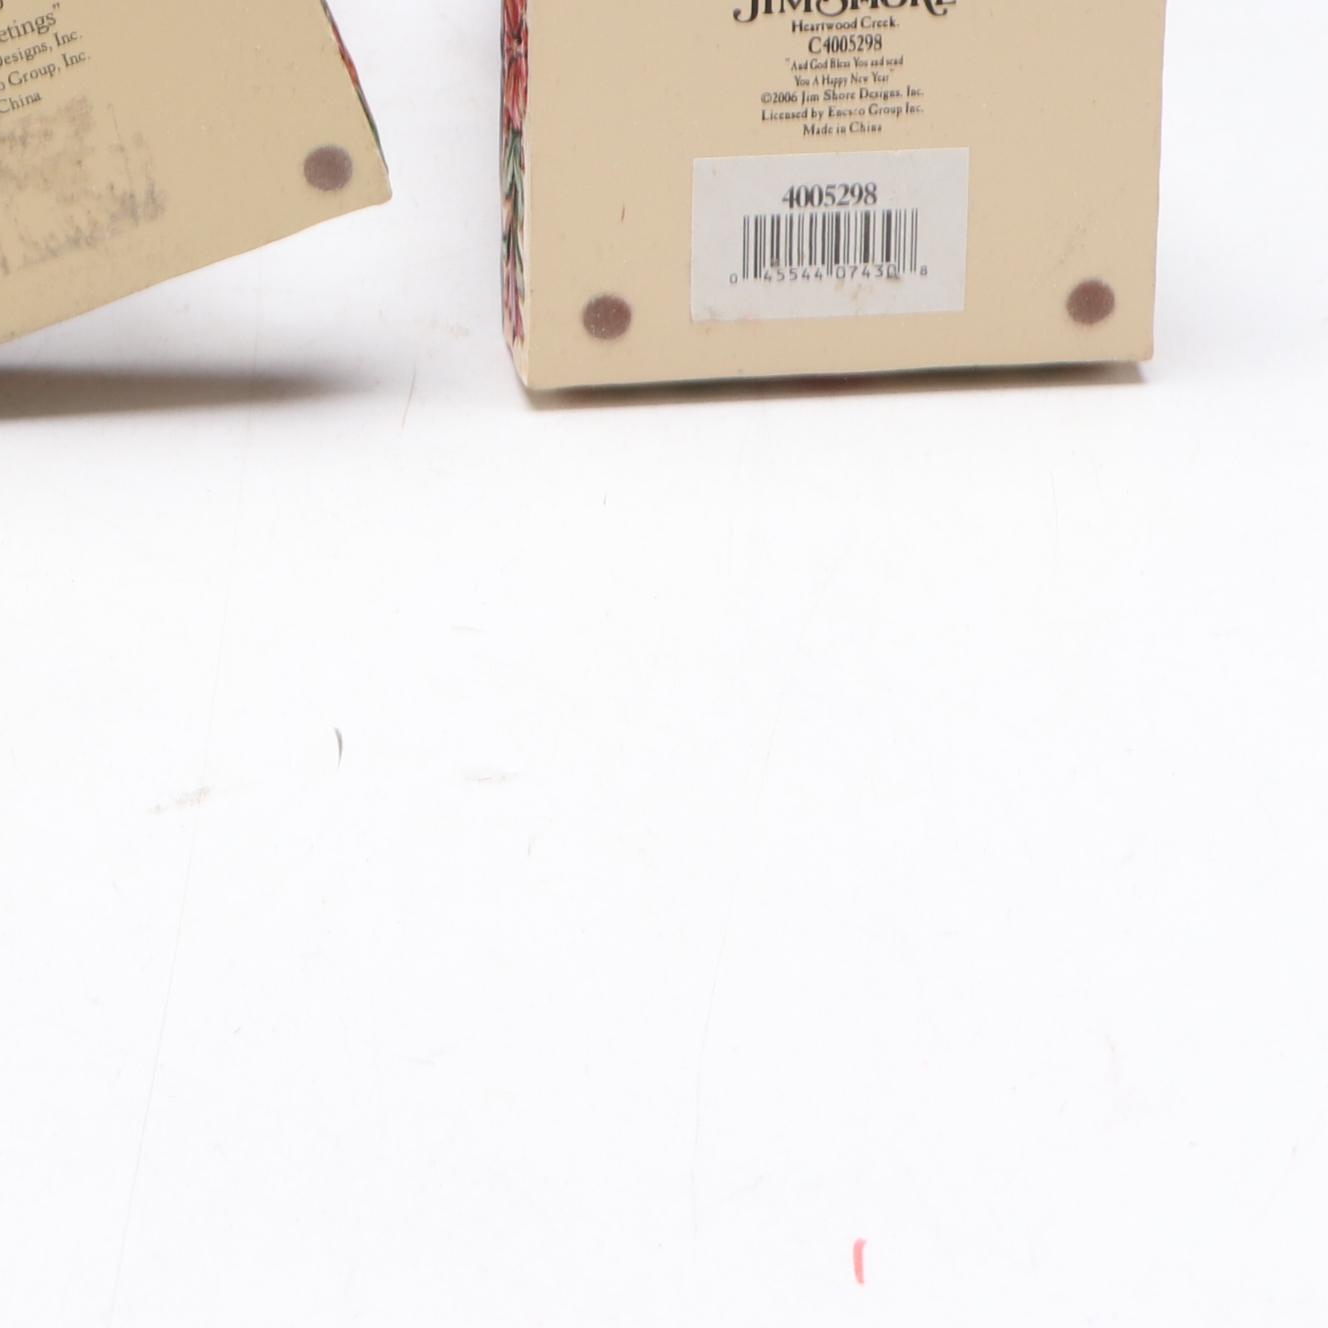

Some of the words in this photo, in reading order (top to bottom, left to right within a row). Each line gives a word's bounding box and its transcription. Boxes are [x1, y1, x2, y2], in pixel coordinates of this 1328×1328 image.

[792, 18, 858, 33] Heartwood
[54, 29, 83, 48] Inc.
[808, 34, 883, 55] C4005298
[7, 62, 61, 87] Group,
[62, 49, 91, 68] Inc.
[810, 58, 828, 70] God
[830, 58, 851, 69] Bless
[853, 57, 868, 68] You
[870, 56, 884, 67] and
[794, 75, 810, 87] You
[812, 76, 819, 87] A
[822, 74, 848, 89] Happy
[850, 73, 868, 84] New
[760, 91, 798, 104] ©2006
[801, 90, 819, 105] Jim
[823, 89, 856, 102] Shore
[906, 85, 925, 98] Inc.
[761, 108, 808, 121] Licensed
[811, 107, 824, 120] by
[828, 106, 866, 118] Enesco
[868, 103, 902, 118] Group
[905, 102, 924, 114] Inc.
[803, 123, 833, 137] Made
[836, 123, 846, 134] in
[849, 121, 882, 134] China
[781, 182, 878, 209] 4005298
[729, 273, 738, 285] 0
[763, 266, 823, 283] 45544
[920, 265, 928, 277] 8
